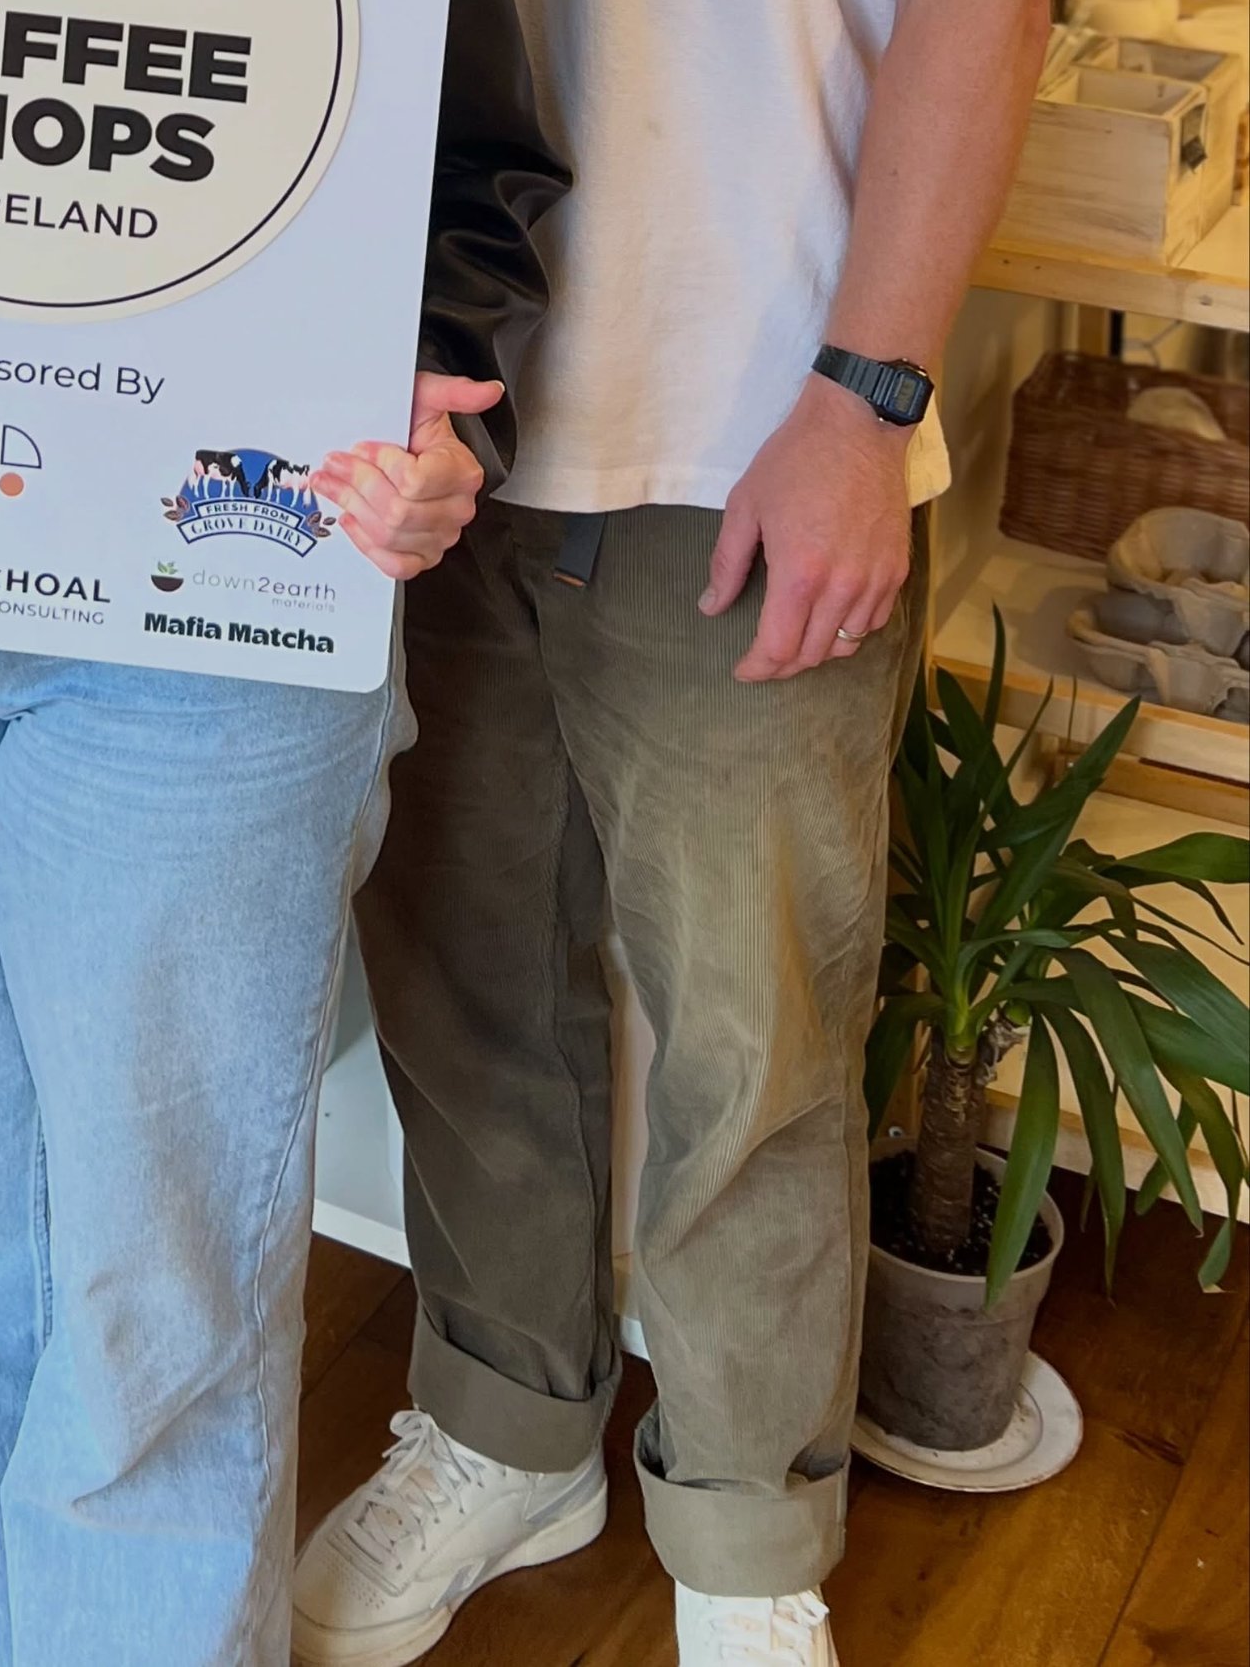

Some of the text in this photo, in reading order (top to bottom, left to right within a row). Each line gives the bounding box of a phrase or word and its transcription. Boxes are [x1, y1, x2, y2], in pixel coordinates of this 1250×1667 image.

[116, 366, 165, 404] By
[206, 502, 290, 523] FRESH FROM
[191, 516, 304, 547] GROVE DAIRY
[192, 569, 336, 601] down2earth
[271, 597, 336, 613] materials
[144, 612, 335, 654] Mafia Matcha
